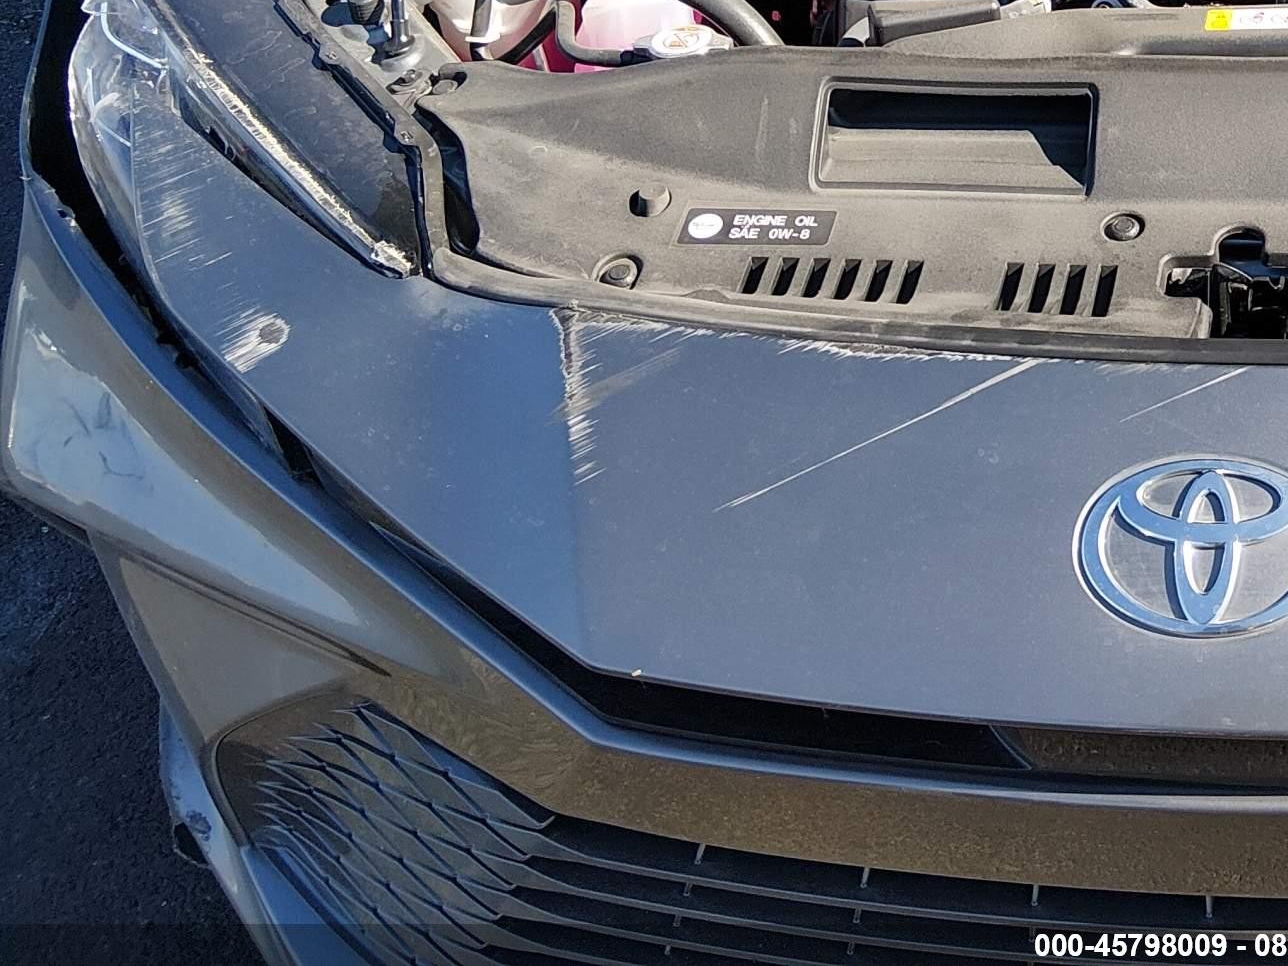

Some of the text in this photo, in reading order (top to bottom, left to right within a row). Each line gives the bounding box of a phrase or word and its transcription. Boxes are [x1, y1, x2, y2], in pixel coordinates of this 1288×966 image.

[732, 214, 818, 227] ENGINE OIL
[728, 227, 811, 240] SAE 0W-8
